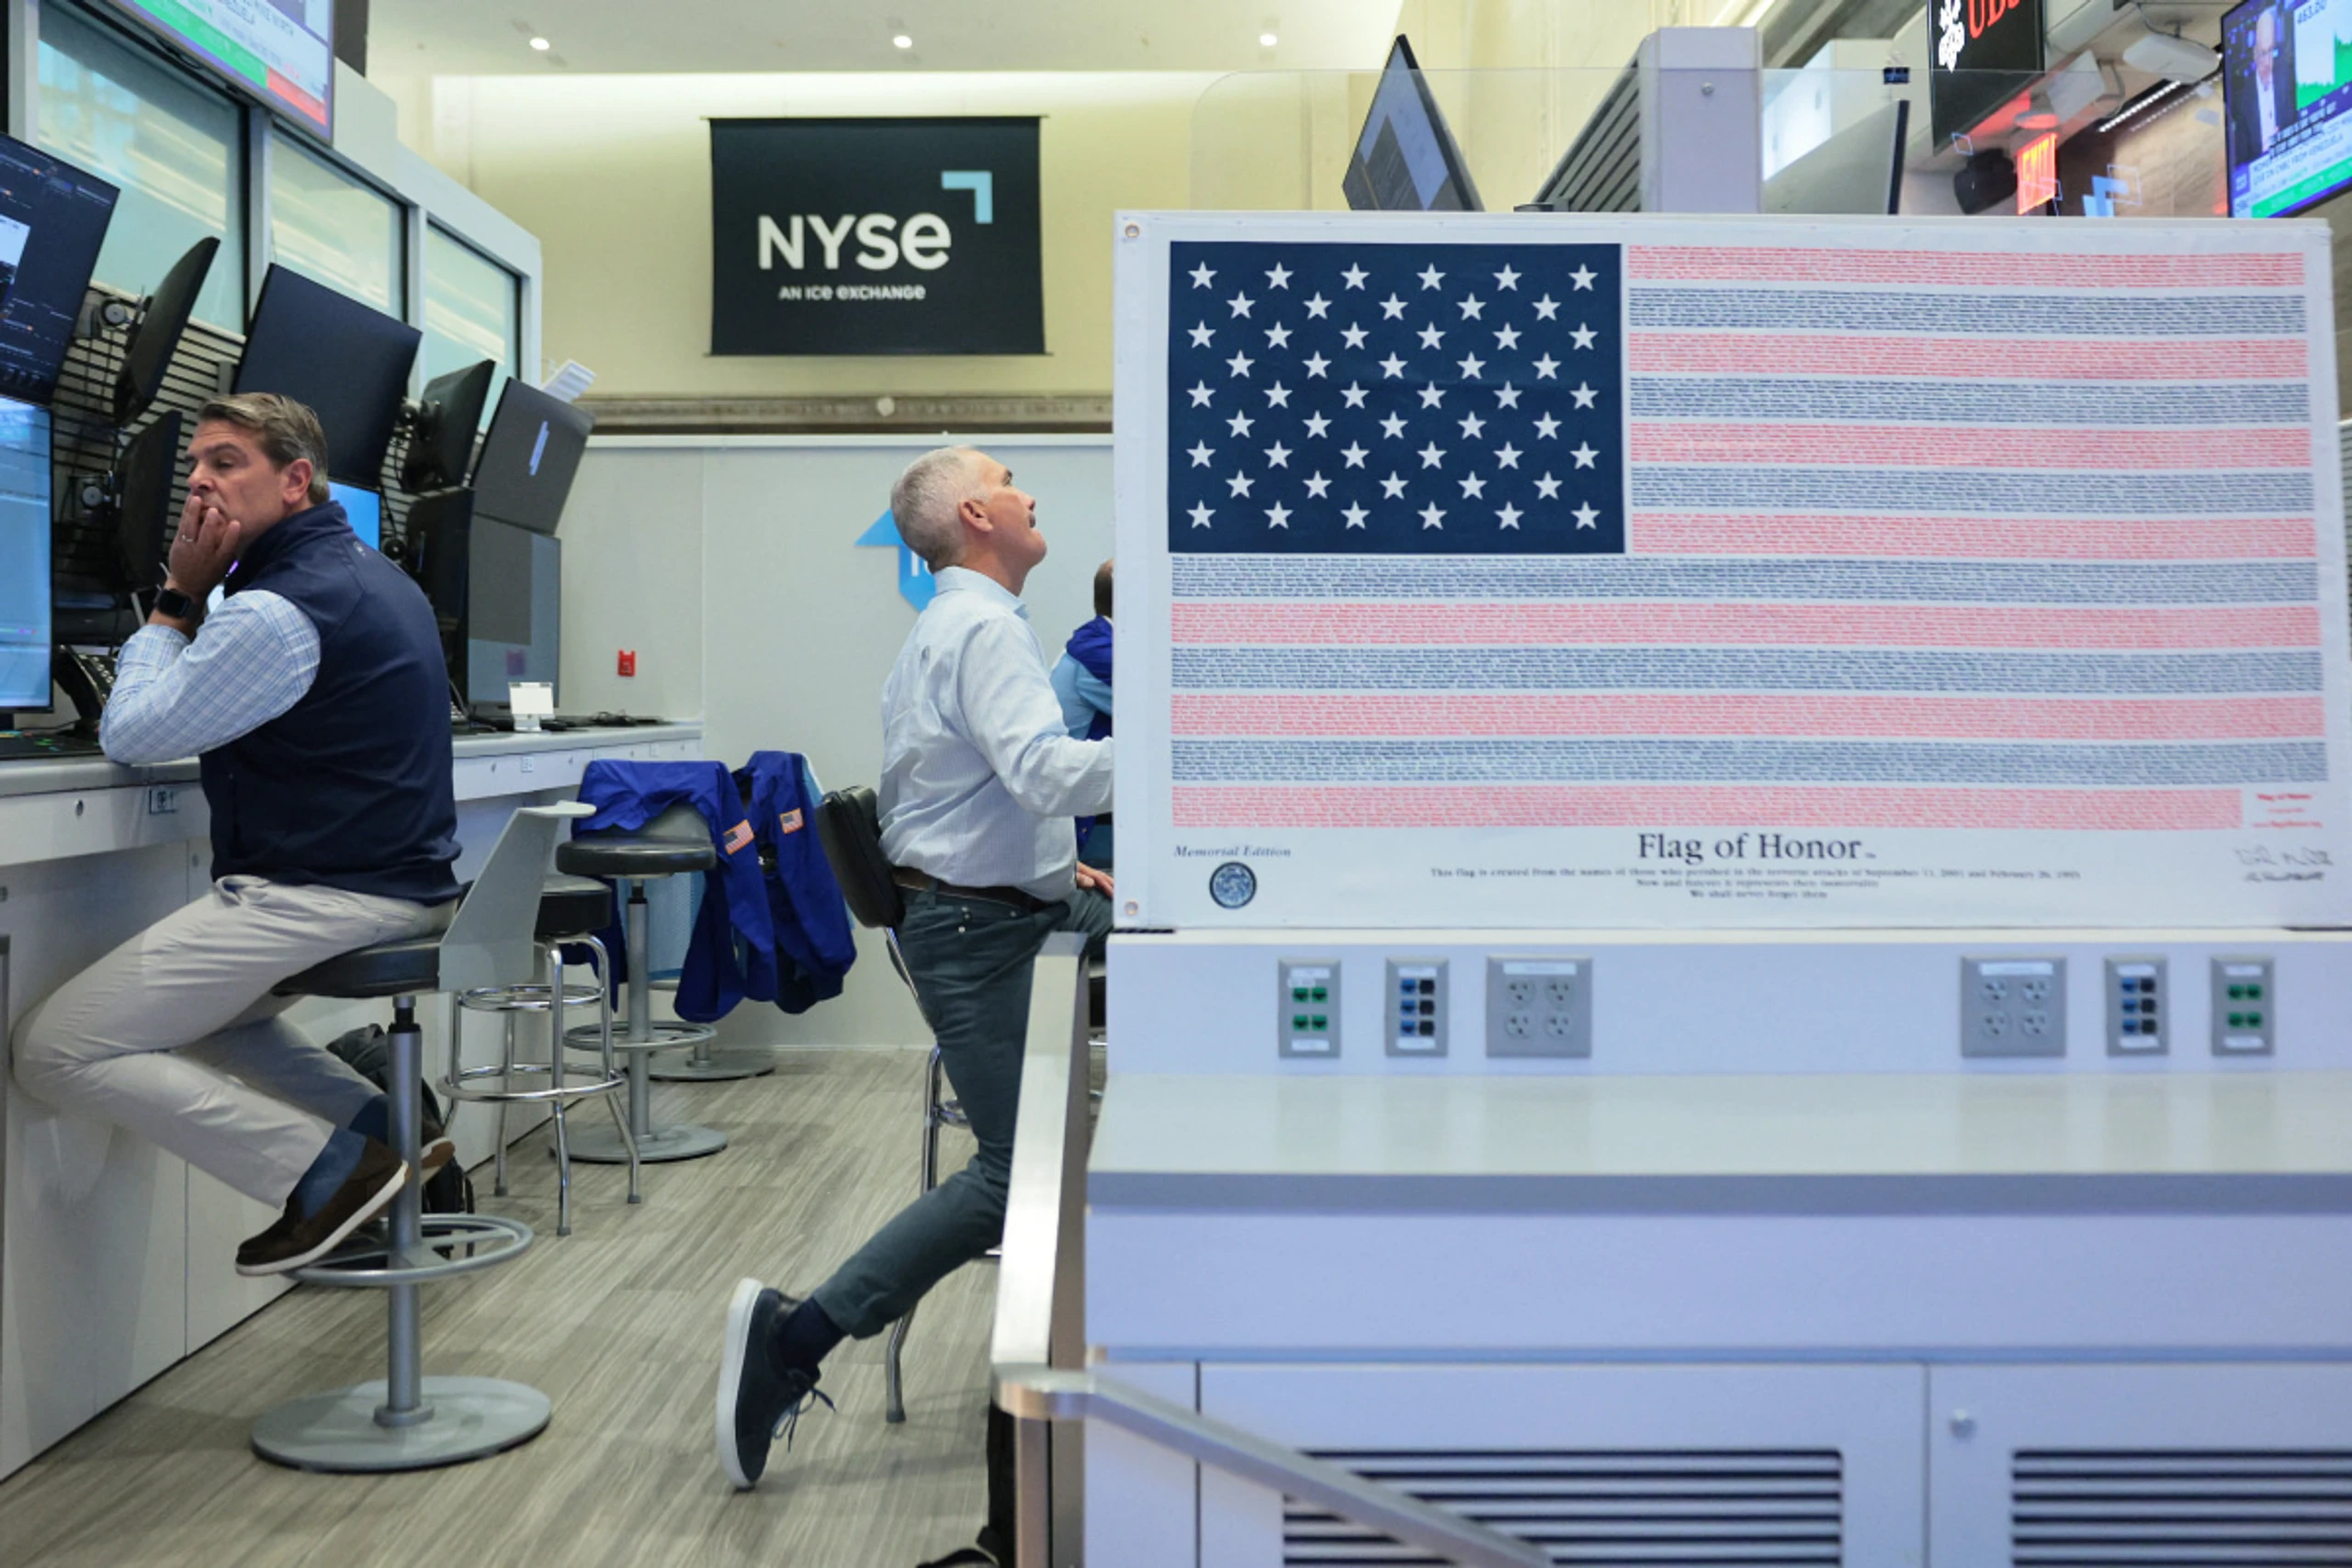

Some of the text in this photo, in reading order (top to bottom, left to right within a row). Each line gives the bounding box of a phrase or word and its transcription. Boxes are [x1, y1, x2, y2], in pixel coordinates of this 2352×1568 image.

[778, 286, 802, 300] AN
[1173, 845, 1292, 857] Memorial Edition
[1638, 832, 1862, 865] Flag of Honor
